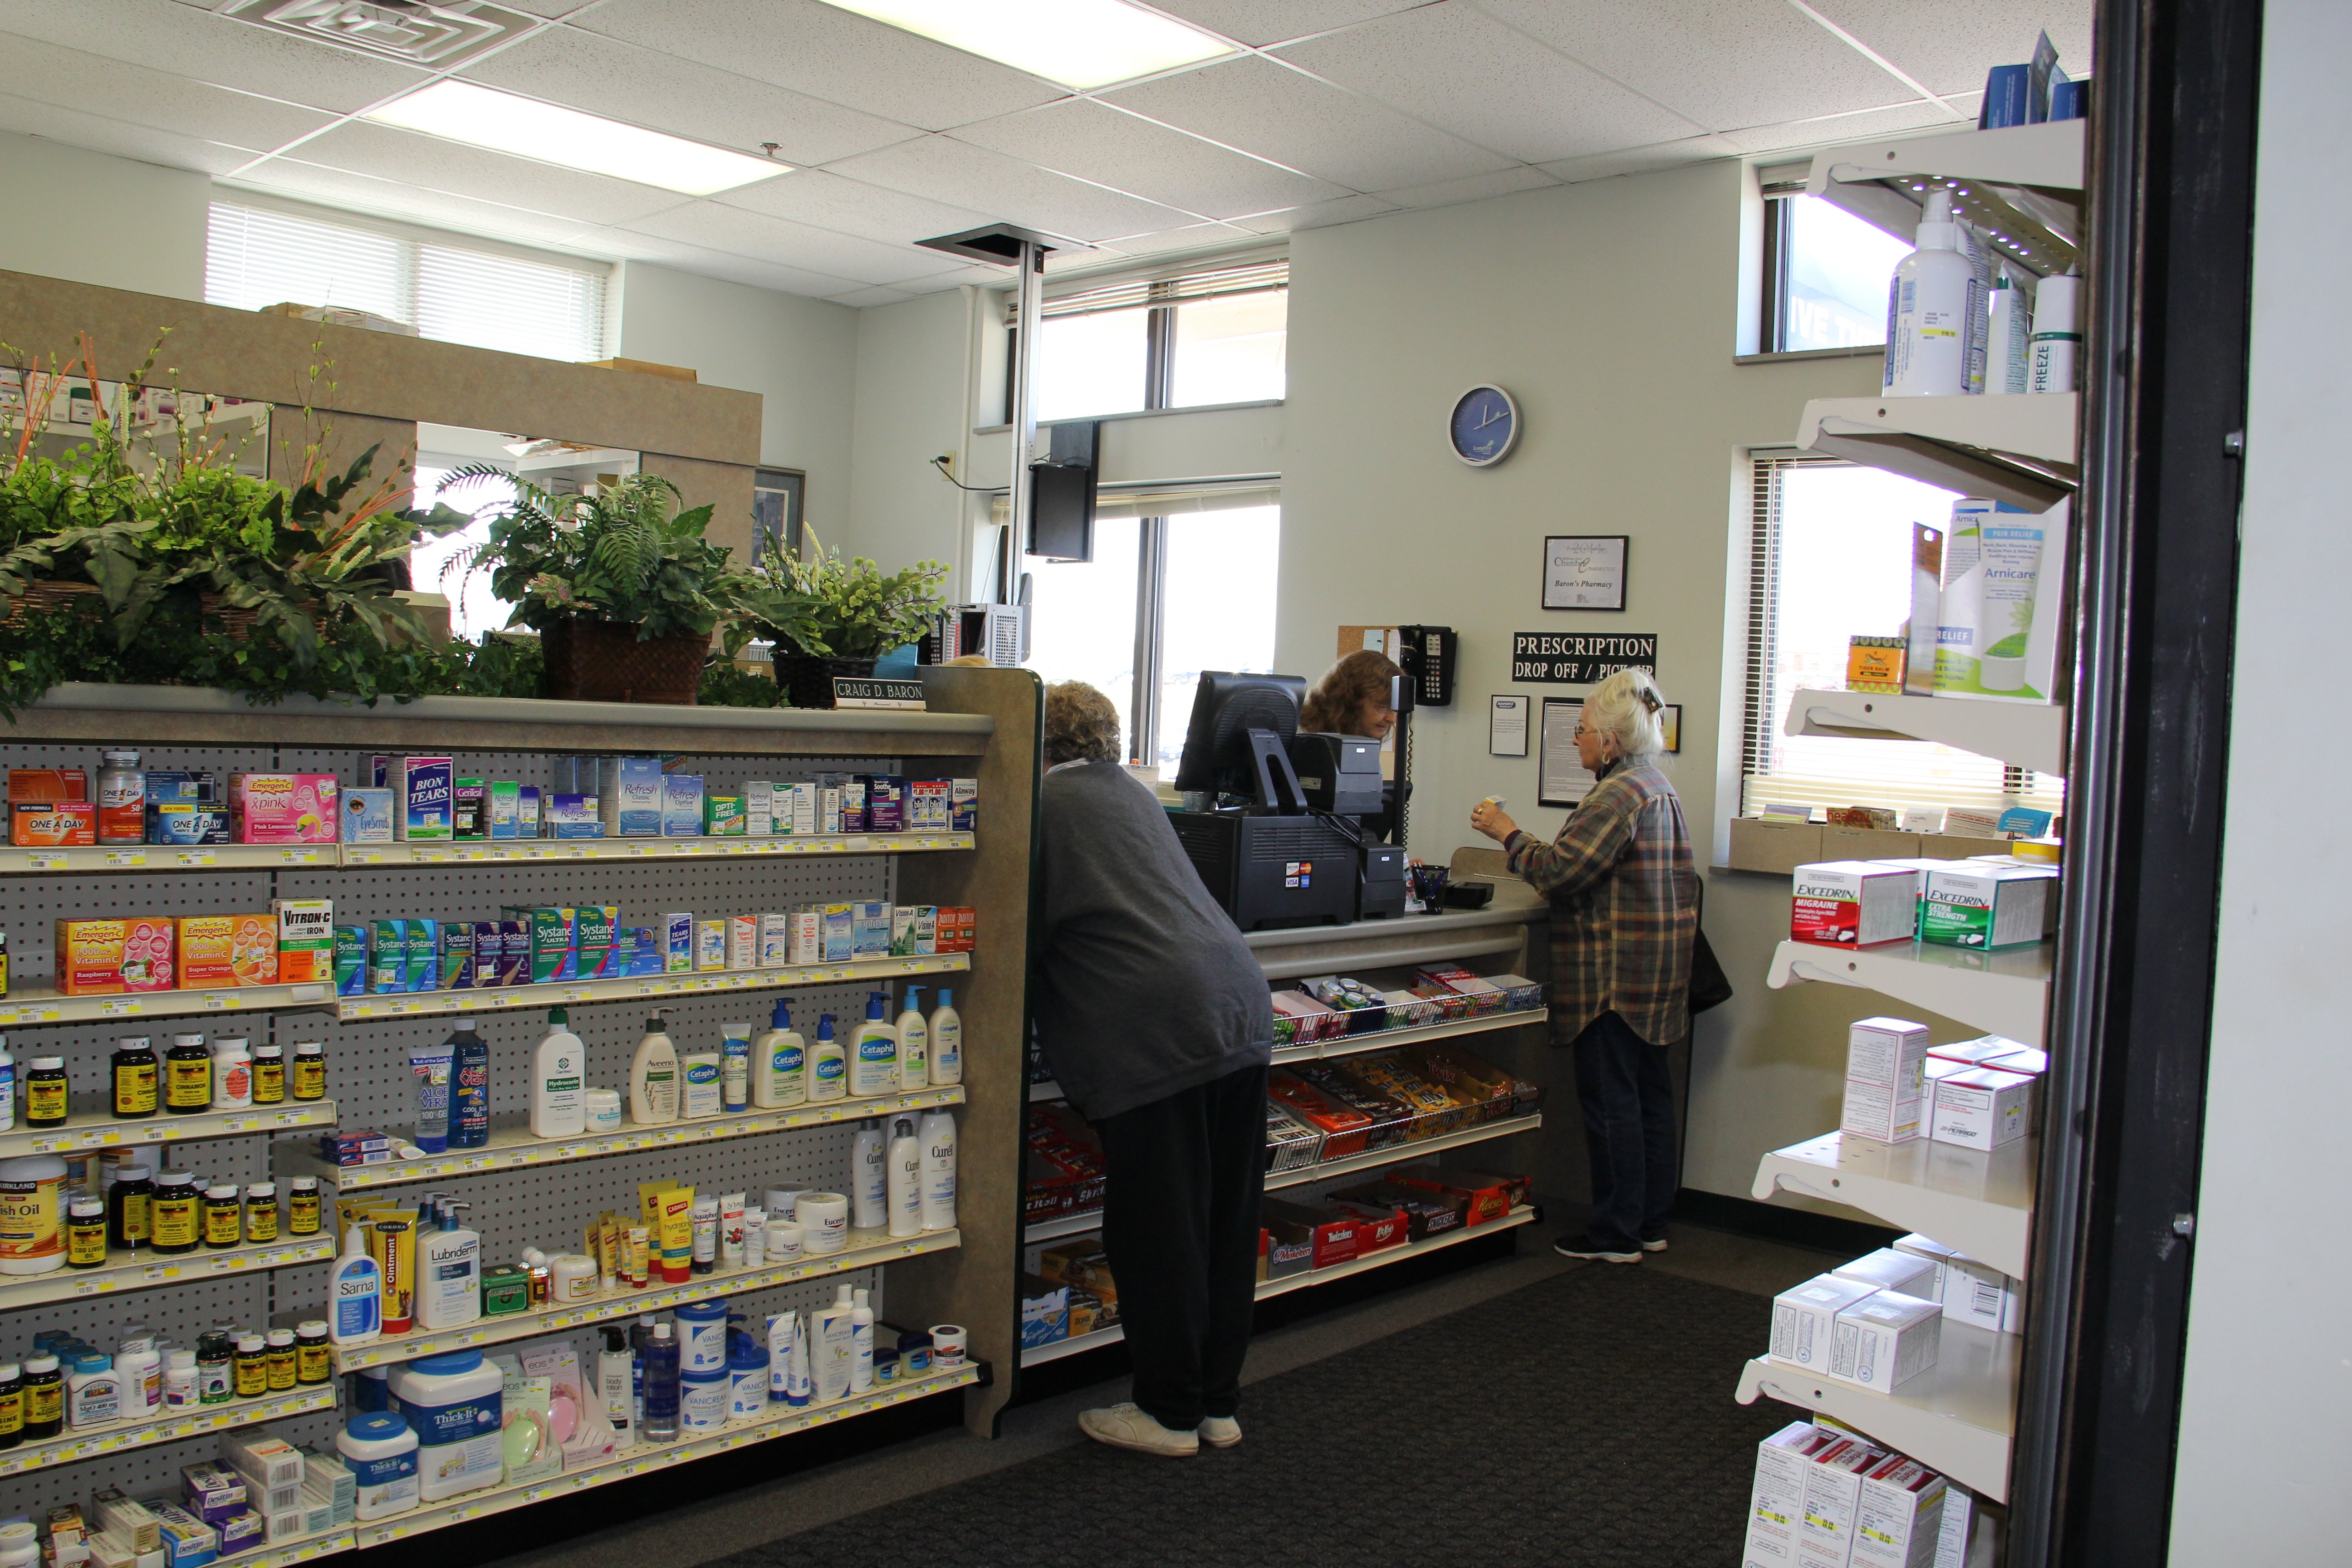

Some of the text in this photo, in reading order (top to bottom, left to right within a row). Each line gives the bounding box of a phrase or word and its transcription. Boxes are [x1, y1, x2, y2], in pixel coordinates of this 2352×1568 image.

[2035, 346, 2049, 393] FREEZE
[1554, 557, 1585, 567] Chamber
[1984, 568, 2036, 579] Arnicare
[1581, 580, 1612, 589] Pharmacy
[1937, 631, 1968, 641] RELIEF
[1516, 637, 1654, 656] PRESCRIPTION
[1515, 662, 1548, 677] DROP
[1554, 663, 1578, 678] OFF
[838, 684, 922, 698] CRAIG D. BARON
[251, 782, 292, 790] Emergen-C
[415, 776, 443, 790] BION
[625, 784, 657, 794] Refresh
[410, 787, 448, 804] TEARS
[457, 788, 483, 797] GenTeal
[669, 789, 700, 799] Refresh
[955, 787, 975, 796] Alaway
[259, 797, 287, 810] pink
[715, 810, 736, 818] FREE
[30, 820, 85, 828] ONE A DAY
[173, 819, 220, 828] ONE A DAY
[361, 817, 389, 831] EyeScrub
[1797, 885, 1856, 899] EXCEDRIN
[1931, 890, 1988, 906] EXCEDRIN
[1795, 898, 1839, 910] MIGRAINE
[1929, 903, 1950, 912] EXTRA
[284, 910, 331, 927] VITRON-C
[1927, 910, 1968, 922] STRENGTH
[76, 930, 122, 938] Emergen-C
[187, 926, 230, 935] Emergen-C
[538, 926, 572, 941] Systane
[580, 923, 615, 939] Systane
[446, 934, 471, 946] Systane
[477, 933, 502, 946] Systane
[504, 932, 529, 946] Systane
[338, 941, 365, 954] Systane
[379, 940, 406, 952] Systane
[409, 939, 436, 952] Systane
[112, 956, 118, 964] C
[77, 971, 112, 979] Raspberry
[1416, 973, 1445, 990] mentos
[1475, 1003, 1503, 1014] mentos
[724, 1044, 749, 1053] Cetaphil
[862, 1044, 894, 1055] Cetaphil
[647, 1059, 674, 1068] Aveeno
[774, 1053, 803, 1065] Cetaphil
[690, 1068, 715, 1079] Cetaphil
[818, 1063, 843, 1073] Cetaphil
[1426, 1060, 1456, 1084] Twix
[548, 1078, 579, 1088] Hydrocerin
[421, 1087, 448, 1098] ALOE
[420, 1097, 448, 1109] VERA
[1947, 1127, 1977, 1137] PERRIGO
[932, 1143, 953, 1158] Curél
[0, 1204, 39, 1216] ish Oil
[668, 1202, 687, 1213] CARMEX
[824, 1216, 846, 1226] Eucerin
[1429, 1212, 1455, 1228] SNICKERS
[1328, 1230, 1353, 1243] Twizzlers
[431, 1244, 478, 1261] Lubriderm
[1279, 1247, 1312, 1262] Musketeers
[386, 1237, 396, 1284] Ointment
[341, 1280, 374, 1296] Sarna
[490, 1286, 524, 1296] BAG BALM
[1074, 1315, 1091, 1325] ZONE
[528, 1361, 547, 1369] eos
[503, 1382, 520, 1391] eos
[607, 1377, 622, 1386] body
[434, 1410, 473, 1425] Thick-It
[369, 1460, 397, 1472] Thick-It
[1818, 1473, 1838, 1484] information
[206, 1492, 233, 1505] Desitin
[1873, 1490, 1893, 1501] information
[226, 1523, 250, 1537] Desitin
[178, 1540, 204, 1554] Desitin
